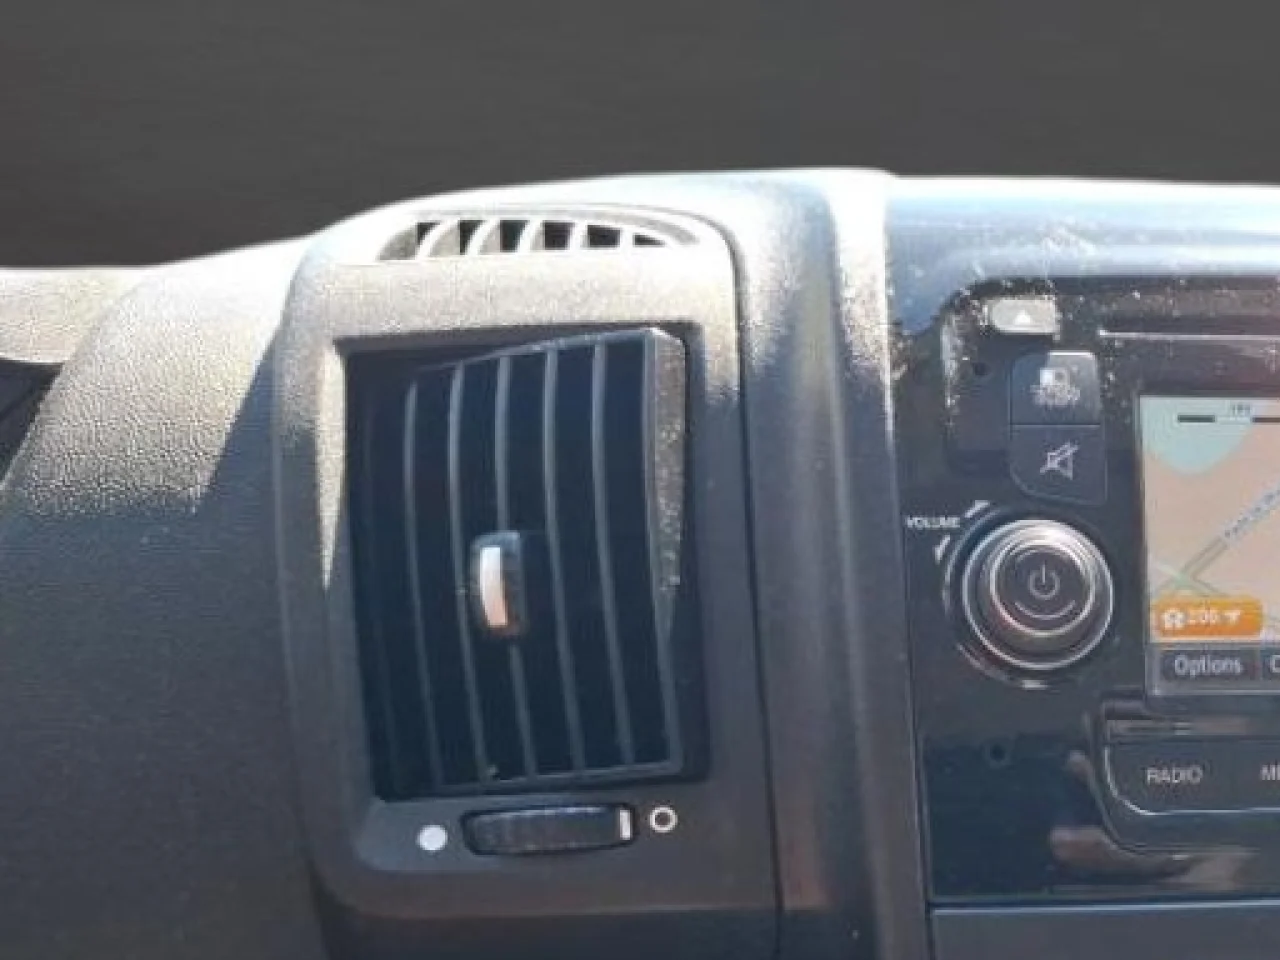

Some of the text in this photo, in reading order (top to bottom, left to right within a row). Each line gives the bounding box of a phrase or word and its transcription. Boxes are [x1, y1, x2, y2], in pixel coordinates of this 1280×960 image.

[906, 515, 961, 530] VOLUME
[1173, 654, 1243, 678] Options
[1145, 765, 1203, 786] RADIO
